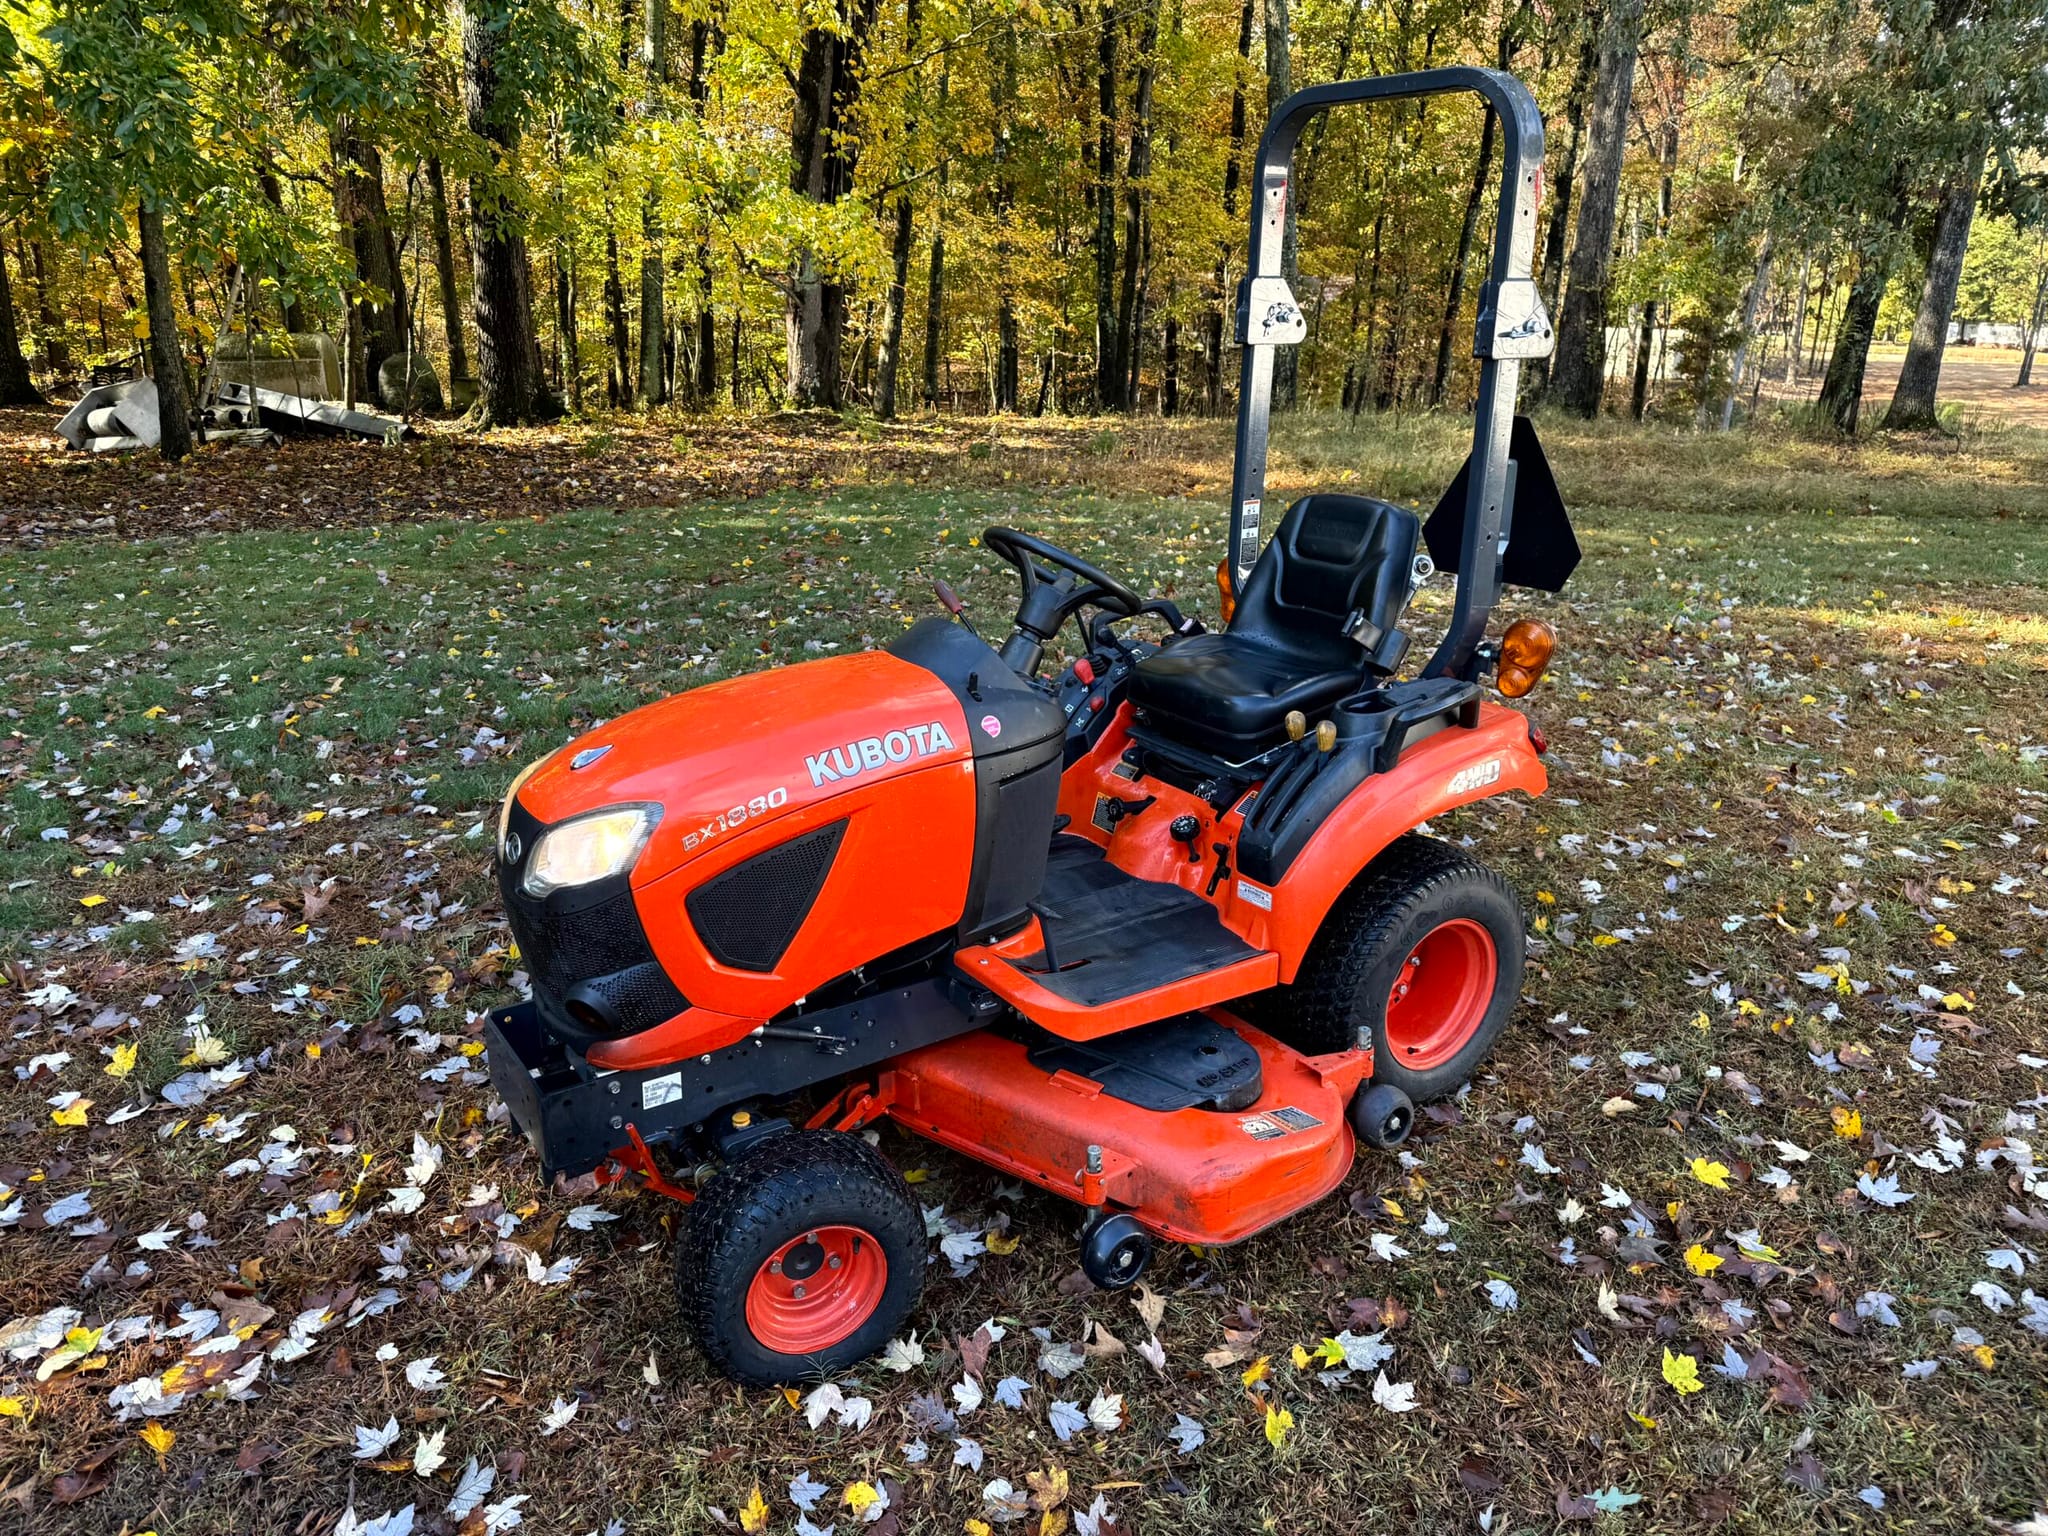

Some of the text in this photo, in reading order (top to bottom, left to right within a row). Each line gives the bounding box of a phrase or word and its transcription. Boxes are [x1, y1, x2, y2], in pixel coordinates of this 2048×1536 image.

[804, 720, 955, 788] KUBOTA
[1445, 758, 1502, 796] 4WD
[681, 786, 788, 852] BX1880
